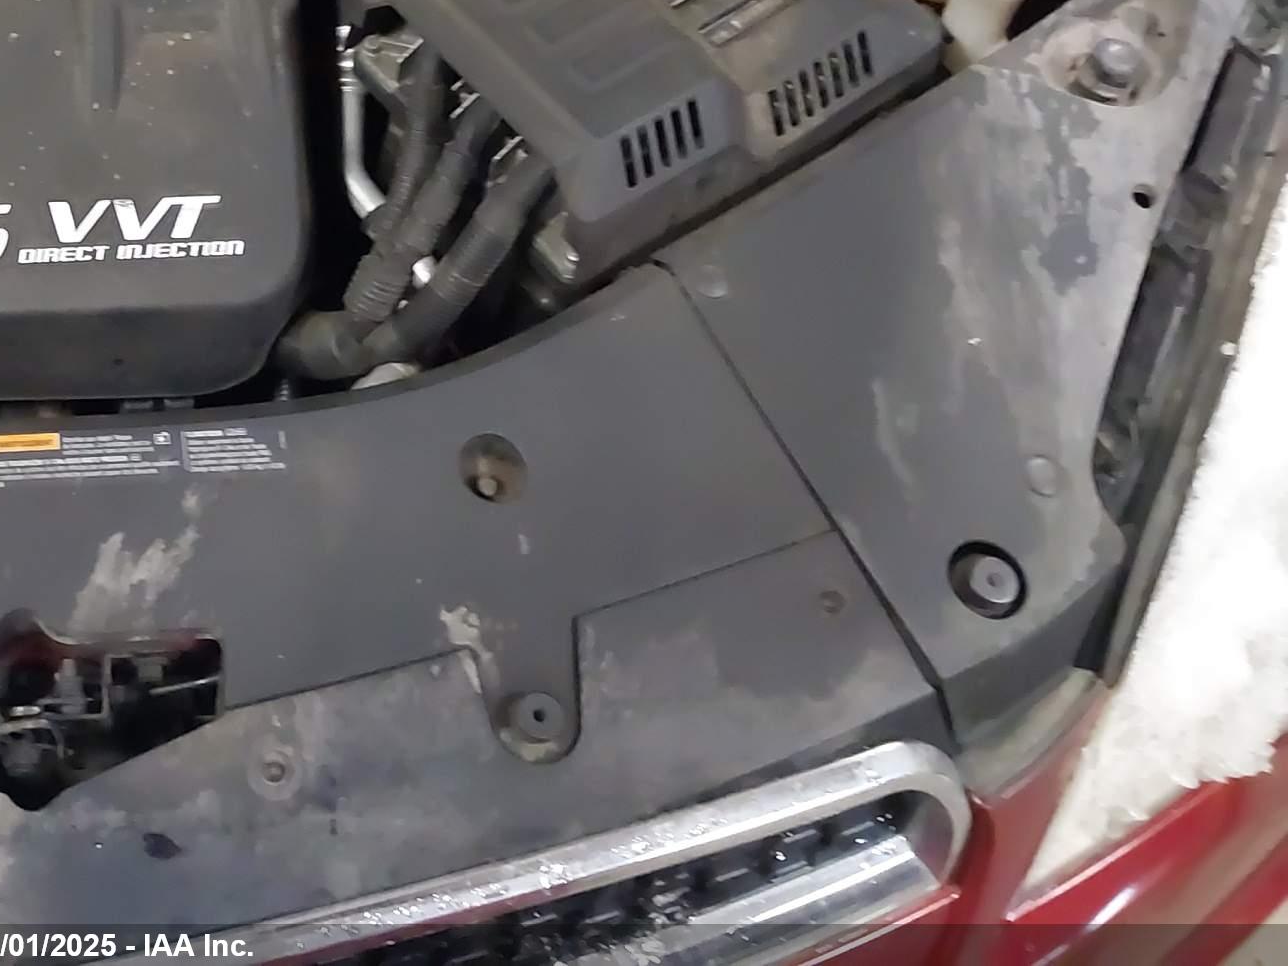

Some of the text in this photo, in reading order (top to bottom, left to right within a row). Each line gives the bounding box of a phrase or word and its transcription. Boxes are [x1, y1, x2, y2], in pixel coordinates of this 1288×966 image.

[47, 194, 223, 243] VVT
[17, 240, 245, 264] DIRECT INJECTION
